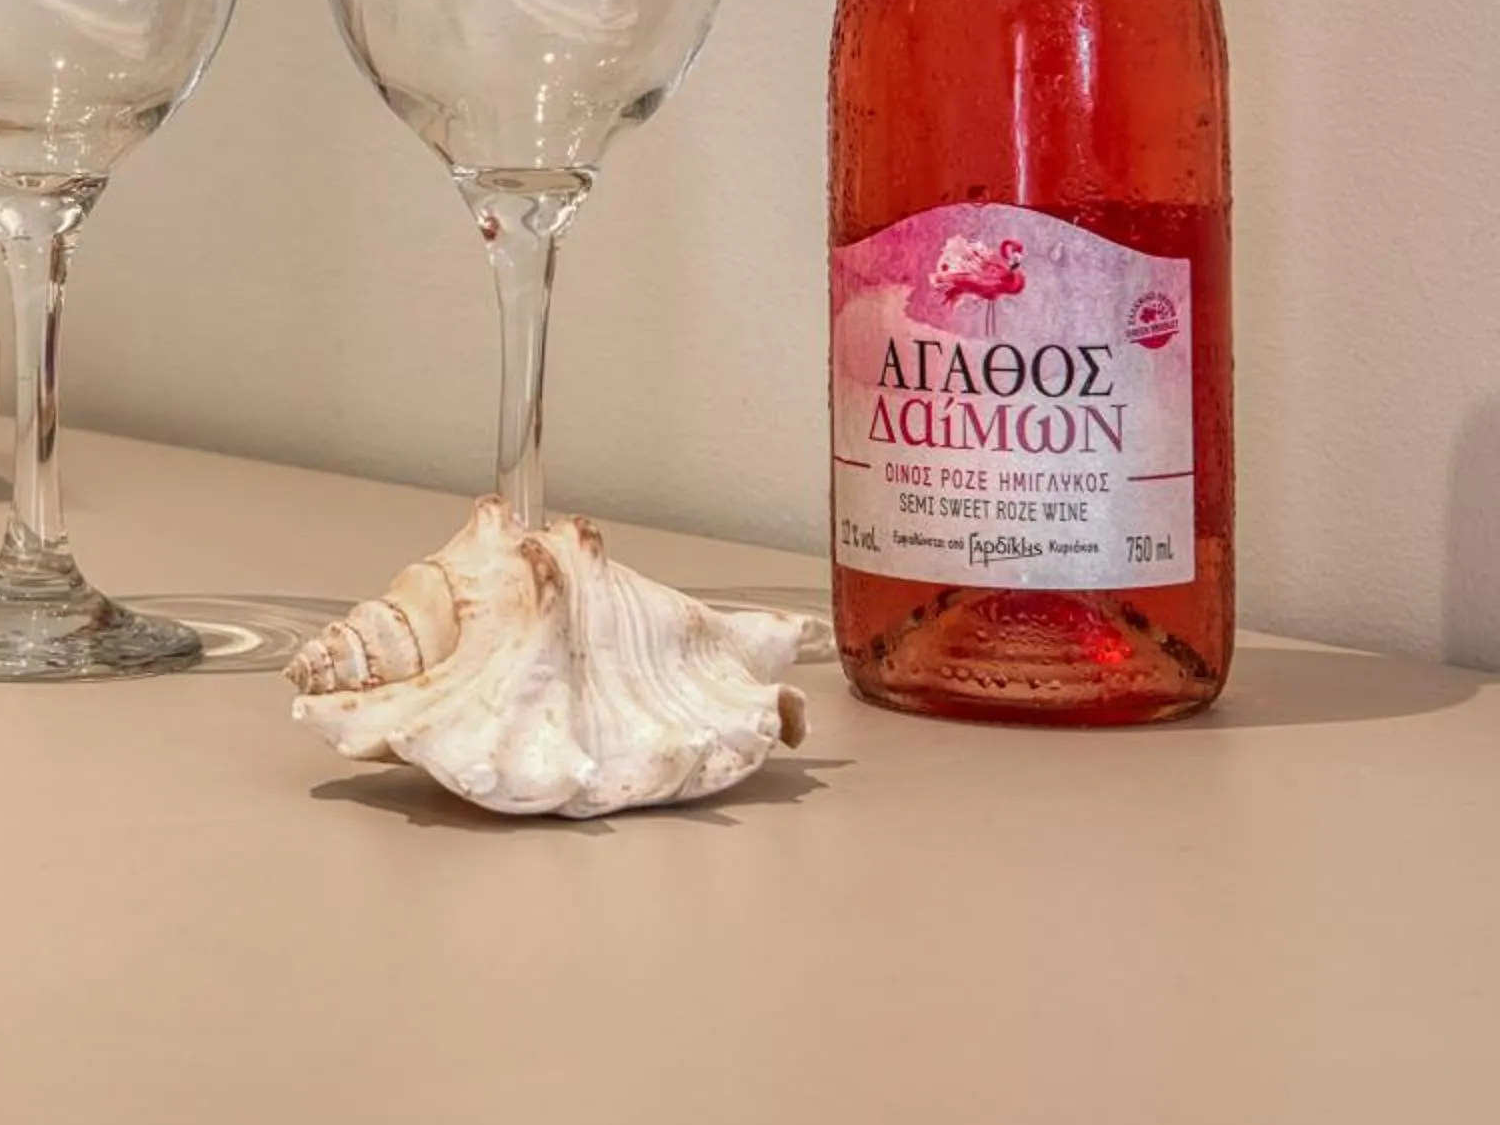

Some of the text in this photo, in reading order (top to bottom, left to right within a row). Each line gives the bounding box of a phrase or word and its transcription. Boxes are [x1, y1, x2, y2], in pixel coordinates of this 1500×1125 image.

[878, 336, 1116, 398] ΑΓΑΘΟΣ
[885, 462, 1110, 493] ΟΙΝΟΣ ΡΟΖΕ ΗΜΙΓΛΥΚΟΣ
[899, 493, 1088, 522] SEMI SWEET ROZE WINE
[1125, 535, 1153, 563] 750
